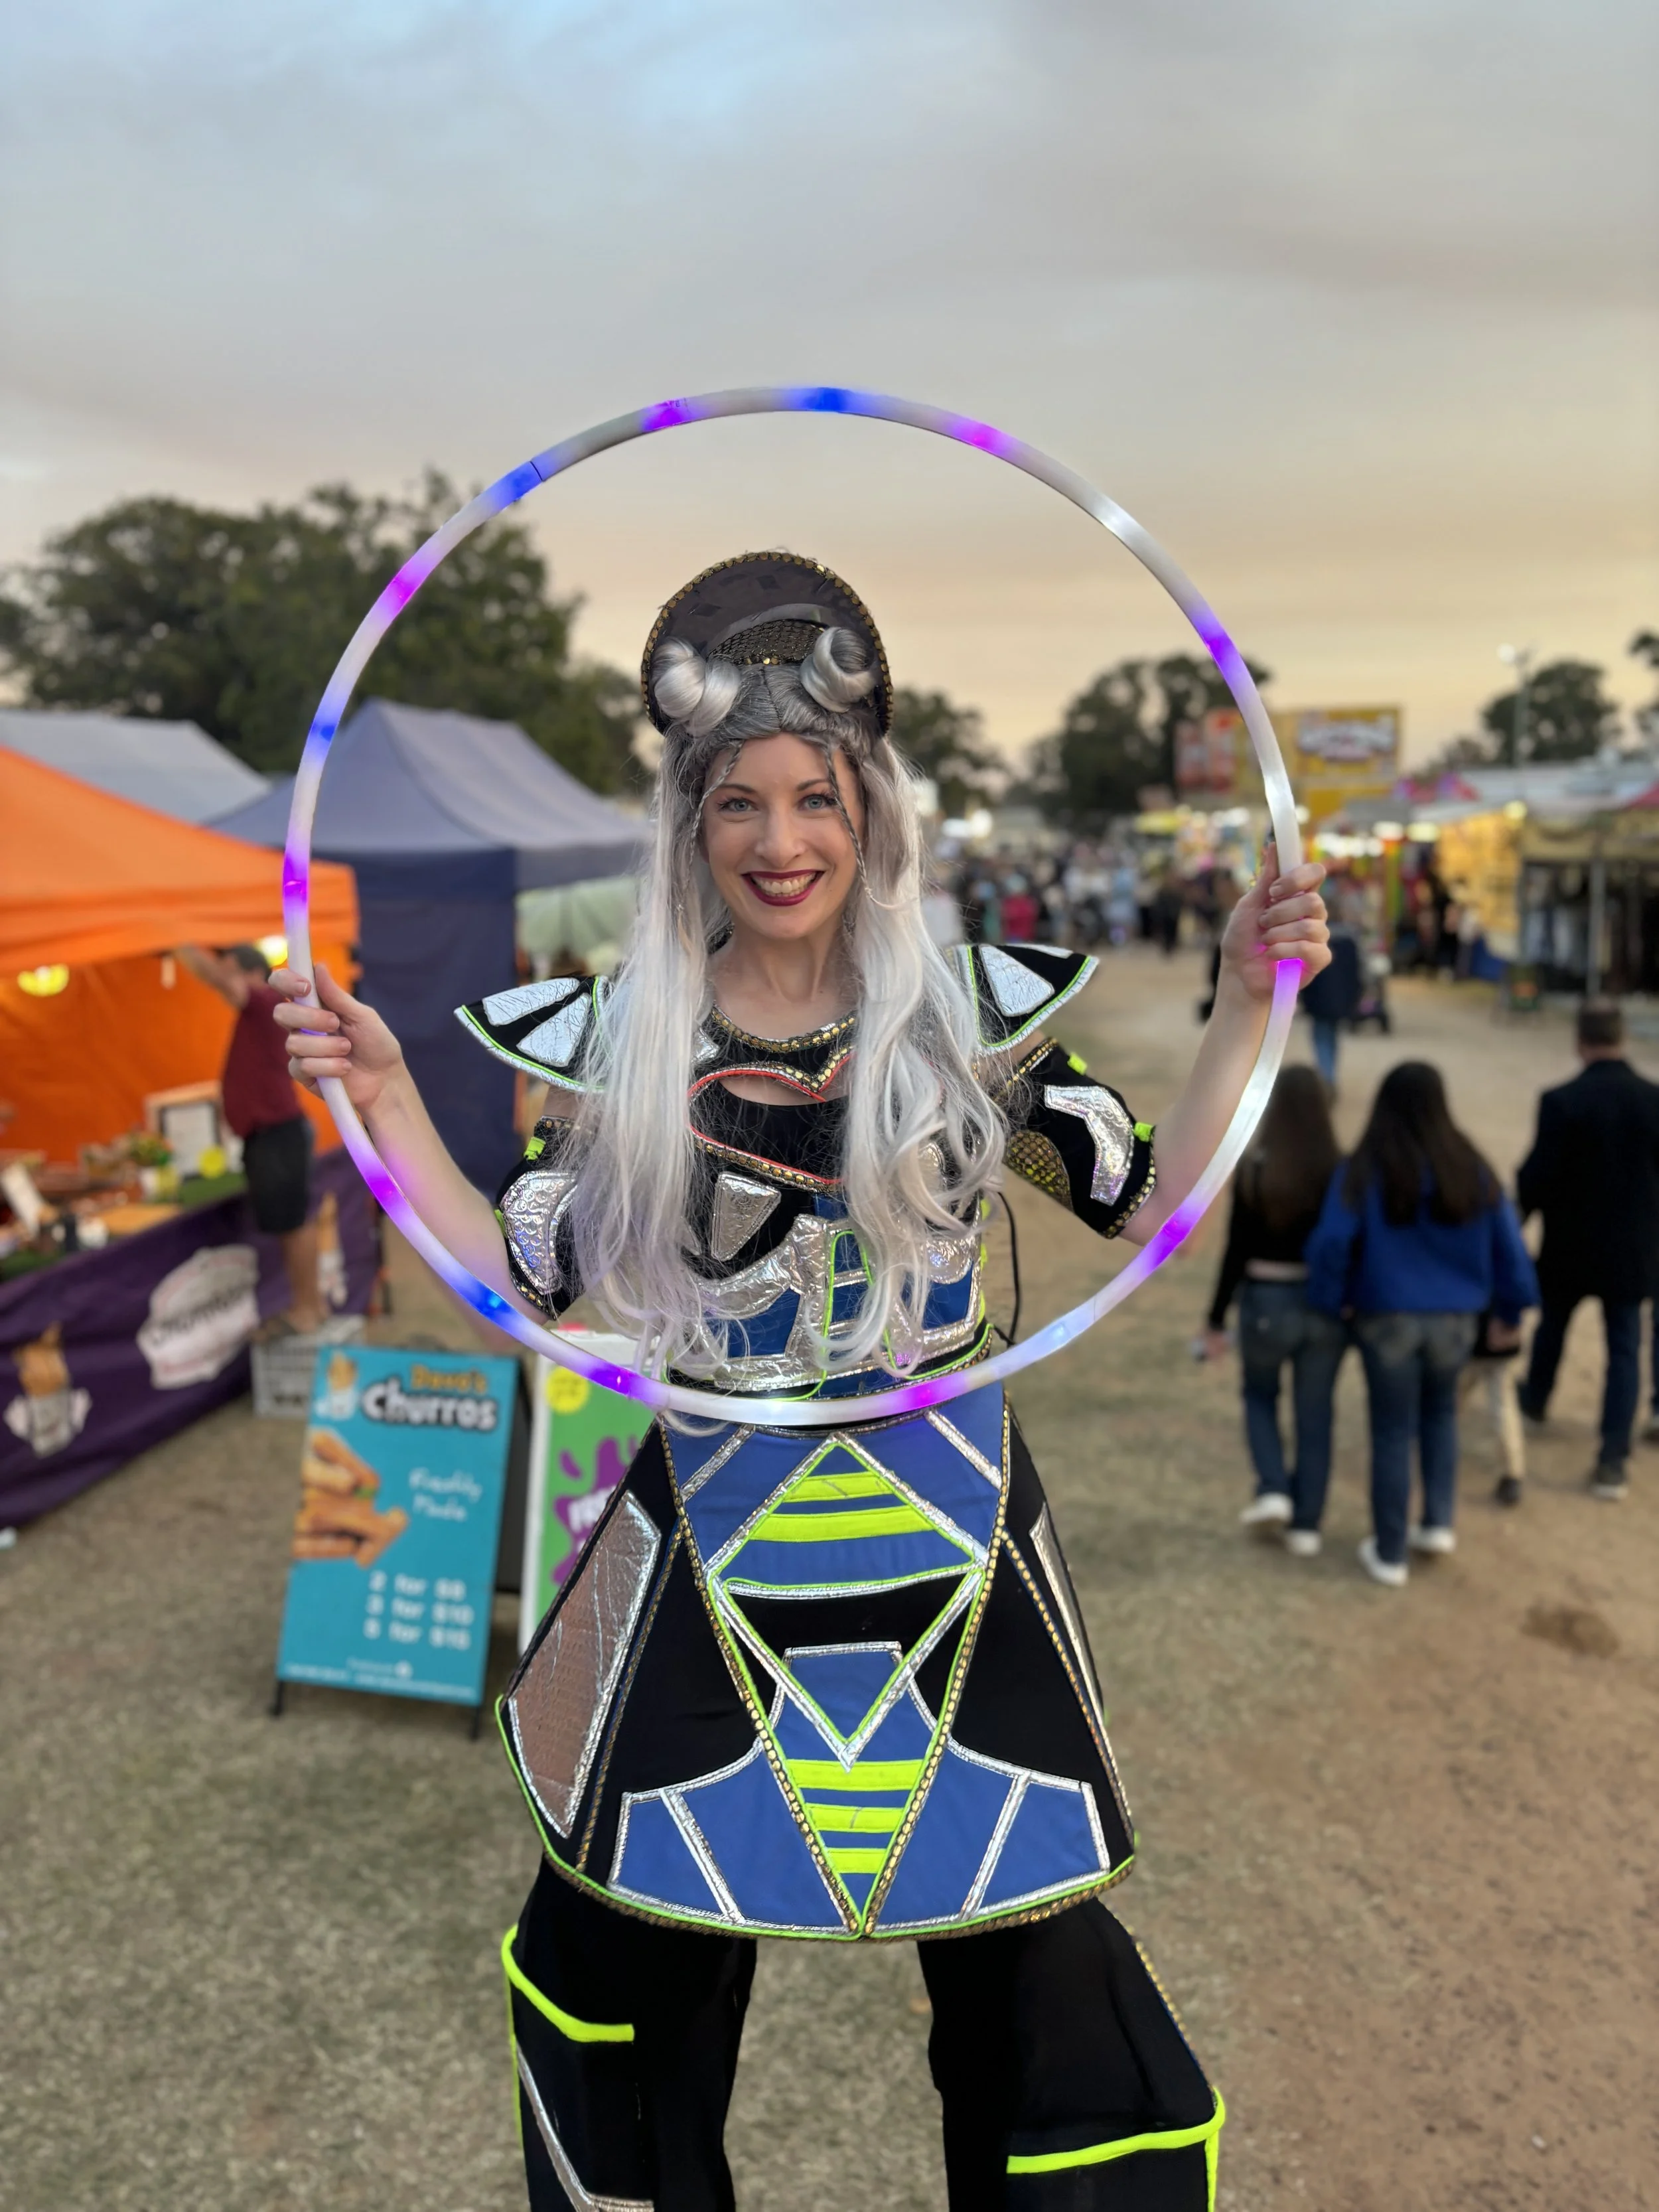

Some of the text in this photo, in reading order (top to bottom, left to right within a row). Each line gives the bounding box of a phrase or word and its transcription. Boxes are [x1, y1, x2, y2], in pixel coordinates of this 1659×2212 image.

[411, 1365, 487, 1394] Dave's
[362, 1376, 497, 1430] Churros
[395, 1574, 426, 1595] for
[391, 1597, 424, 1619] for
[389, 1621, 422, 1643] for
